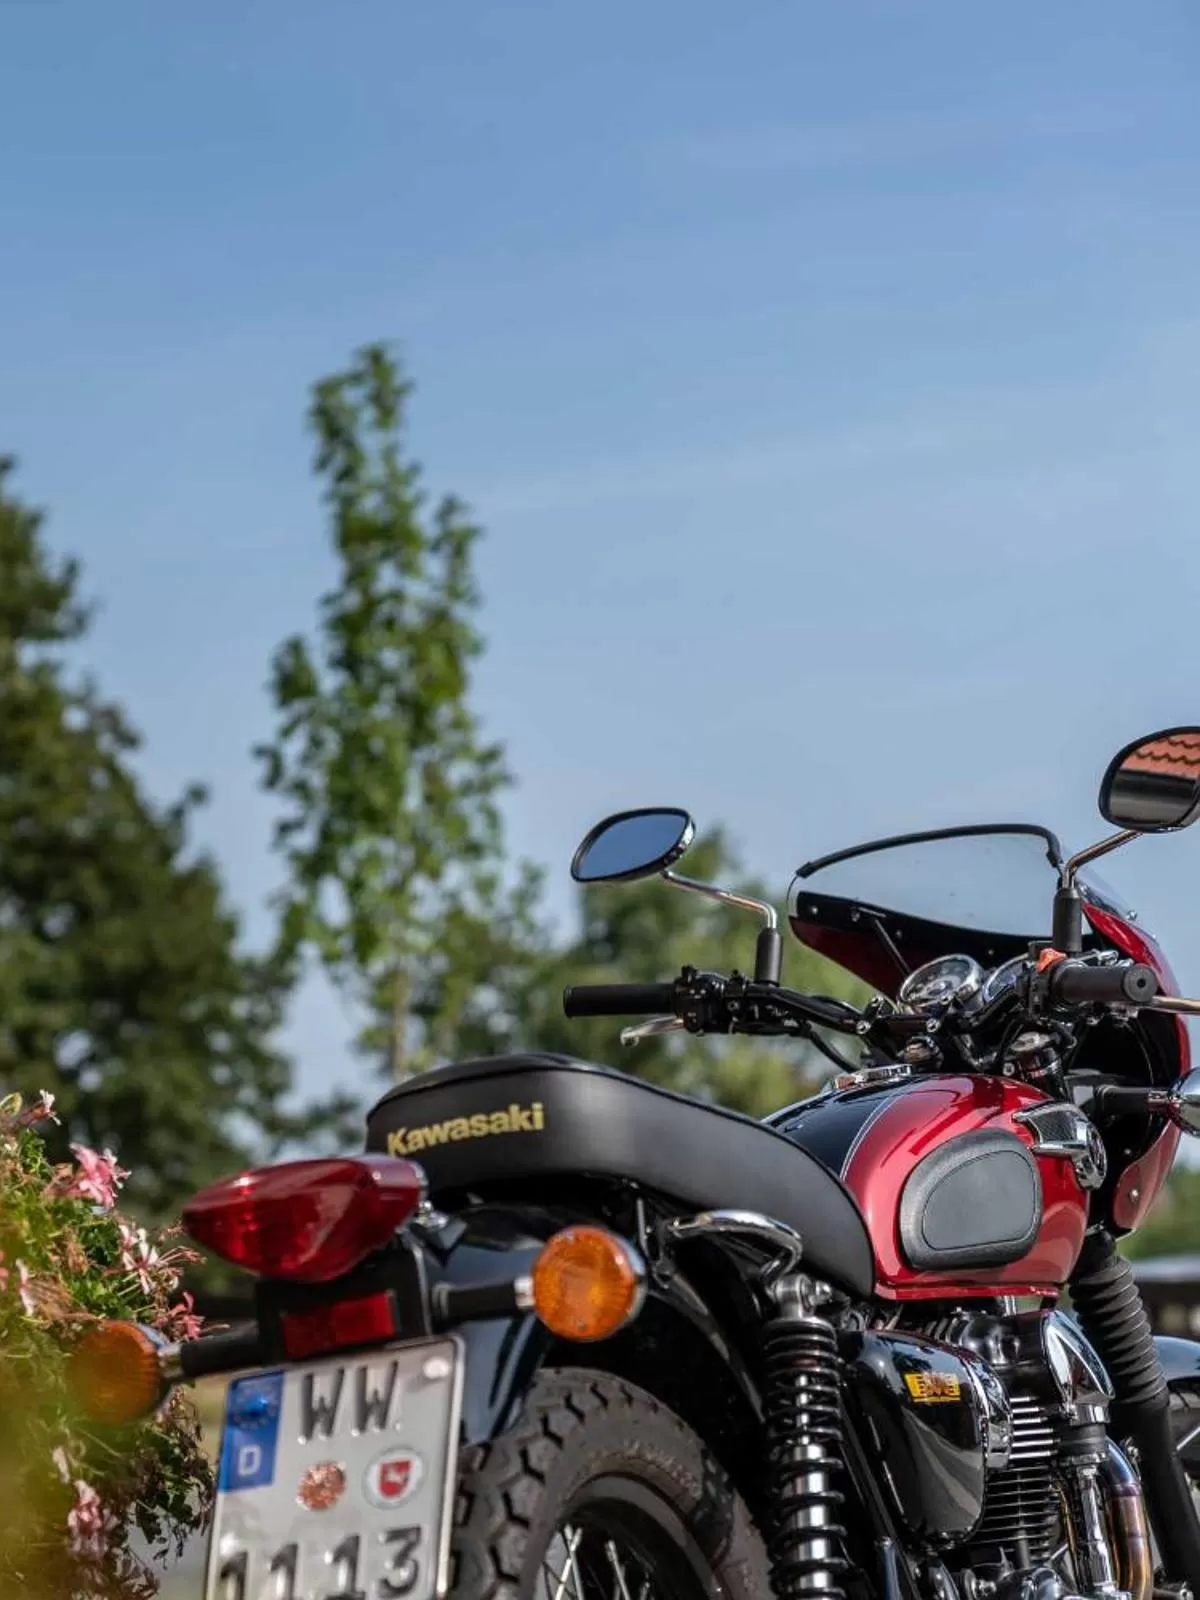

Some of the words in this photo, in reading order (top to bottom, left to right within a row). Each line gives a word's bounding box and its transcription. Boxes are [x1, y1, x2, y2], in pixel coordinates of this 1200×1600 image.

[387, 1102, 545, 1157] Kawasaki
[299, 1359, 400, 1442] WW
[237, 1444, 263, 1477] D
